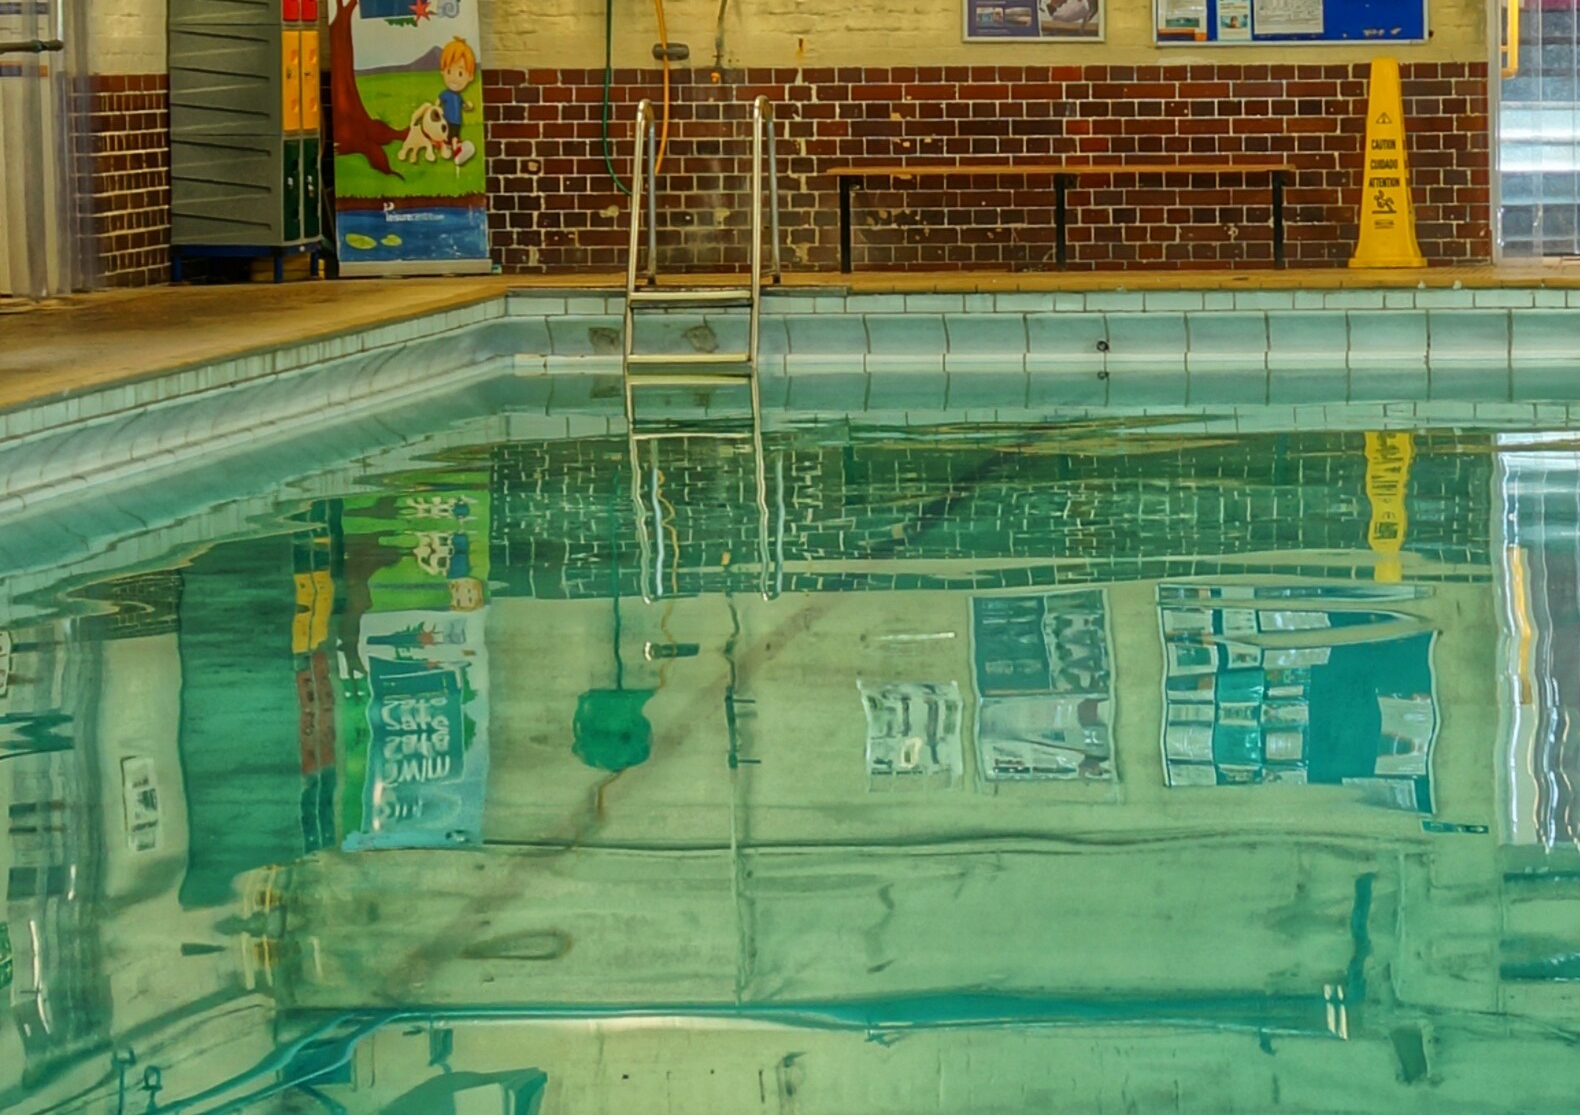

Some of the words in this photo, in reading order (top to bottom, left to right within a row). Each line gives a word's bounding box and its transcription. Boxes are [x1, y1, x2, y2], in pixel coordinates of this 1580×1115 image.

[1371, 139, 1396, 150] CAUTION
[1370, 158, 1398, 170] CUIDADO
[1368, 177, 1400, 188] ATTENTION
